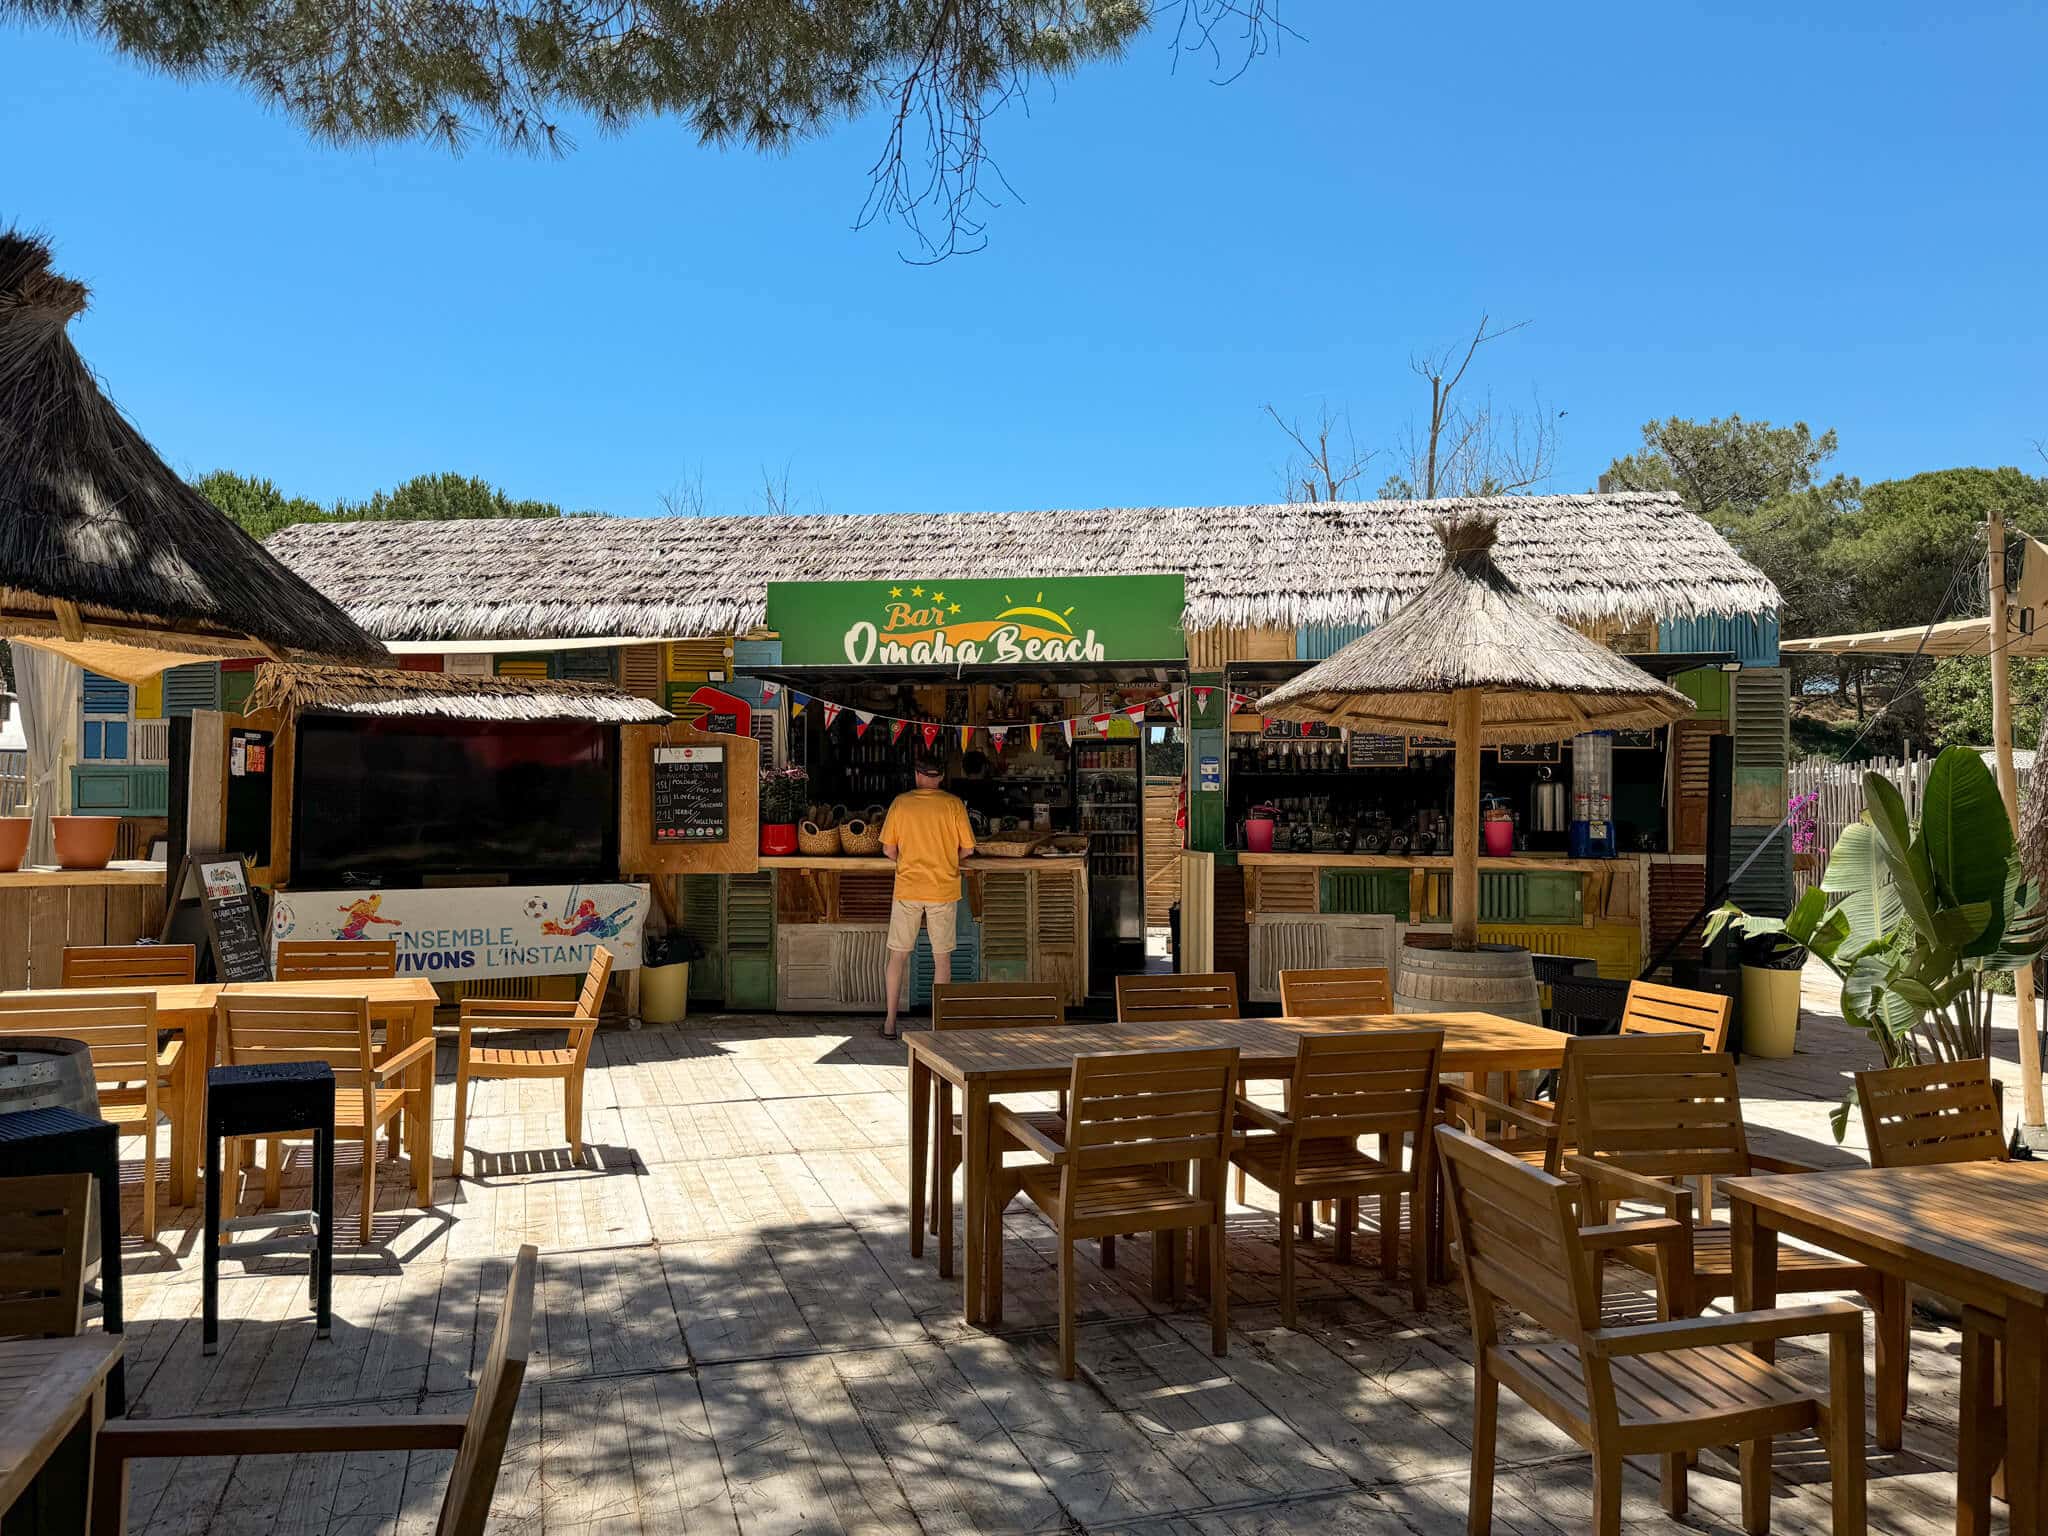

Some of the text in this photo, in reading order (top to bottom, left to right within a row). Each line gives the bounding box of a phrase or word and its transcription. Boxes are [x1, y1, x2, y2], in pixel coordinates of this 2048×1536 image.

[883, 602, 945, 631] Bar
[844, 621, 1105, 664] Omaha Beach
[388, 927, 520, 950] ENSEMBLE,
